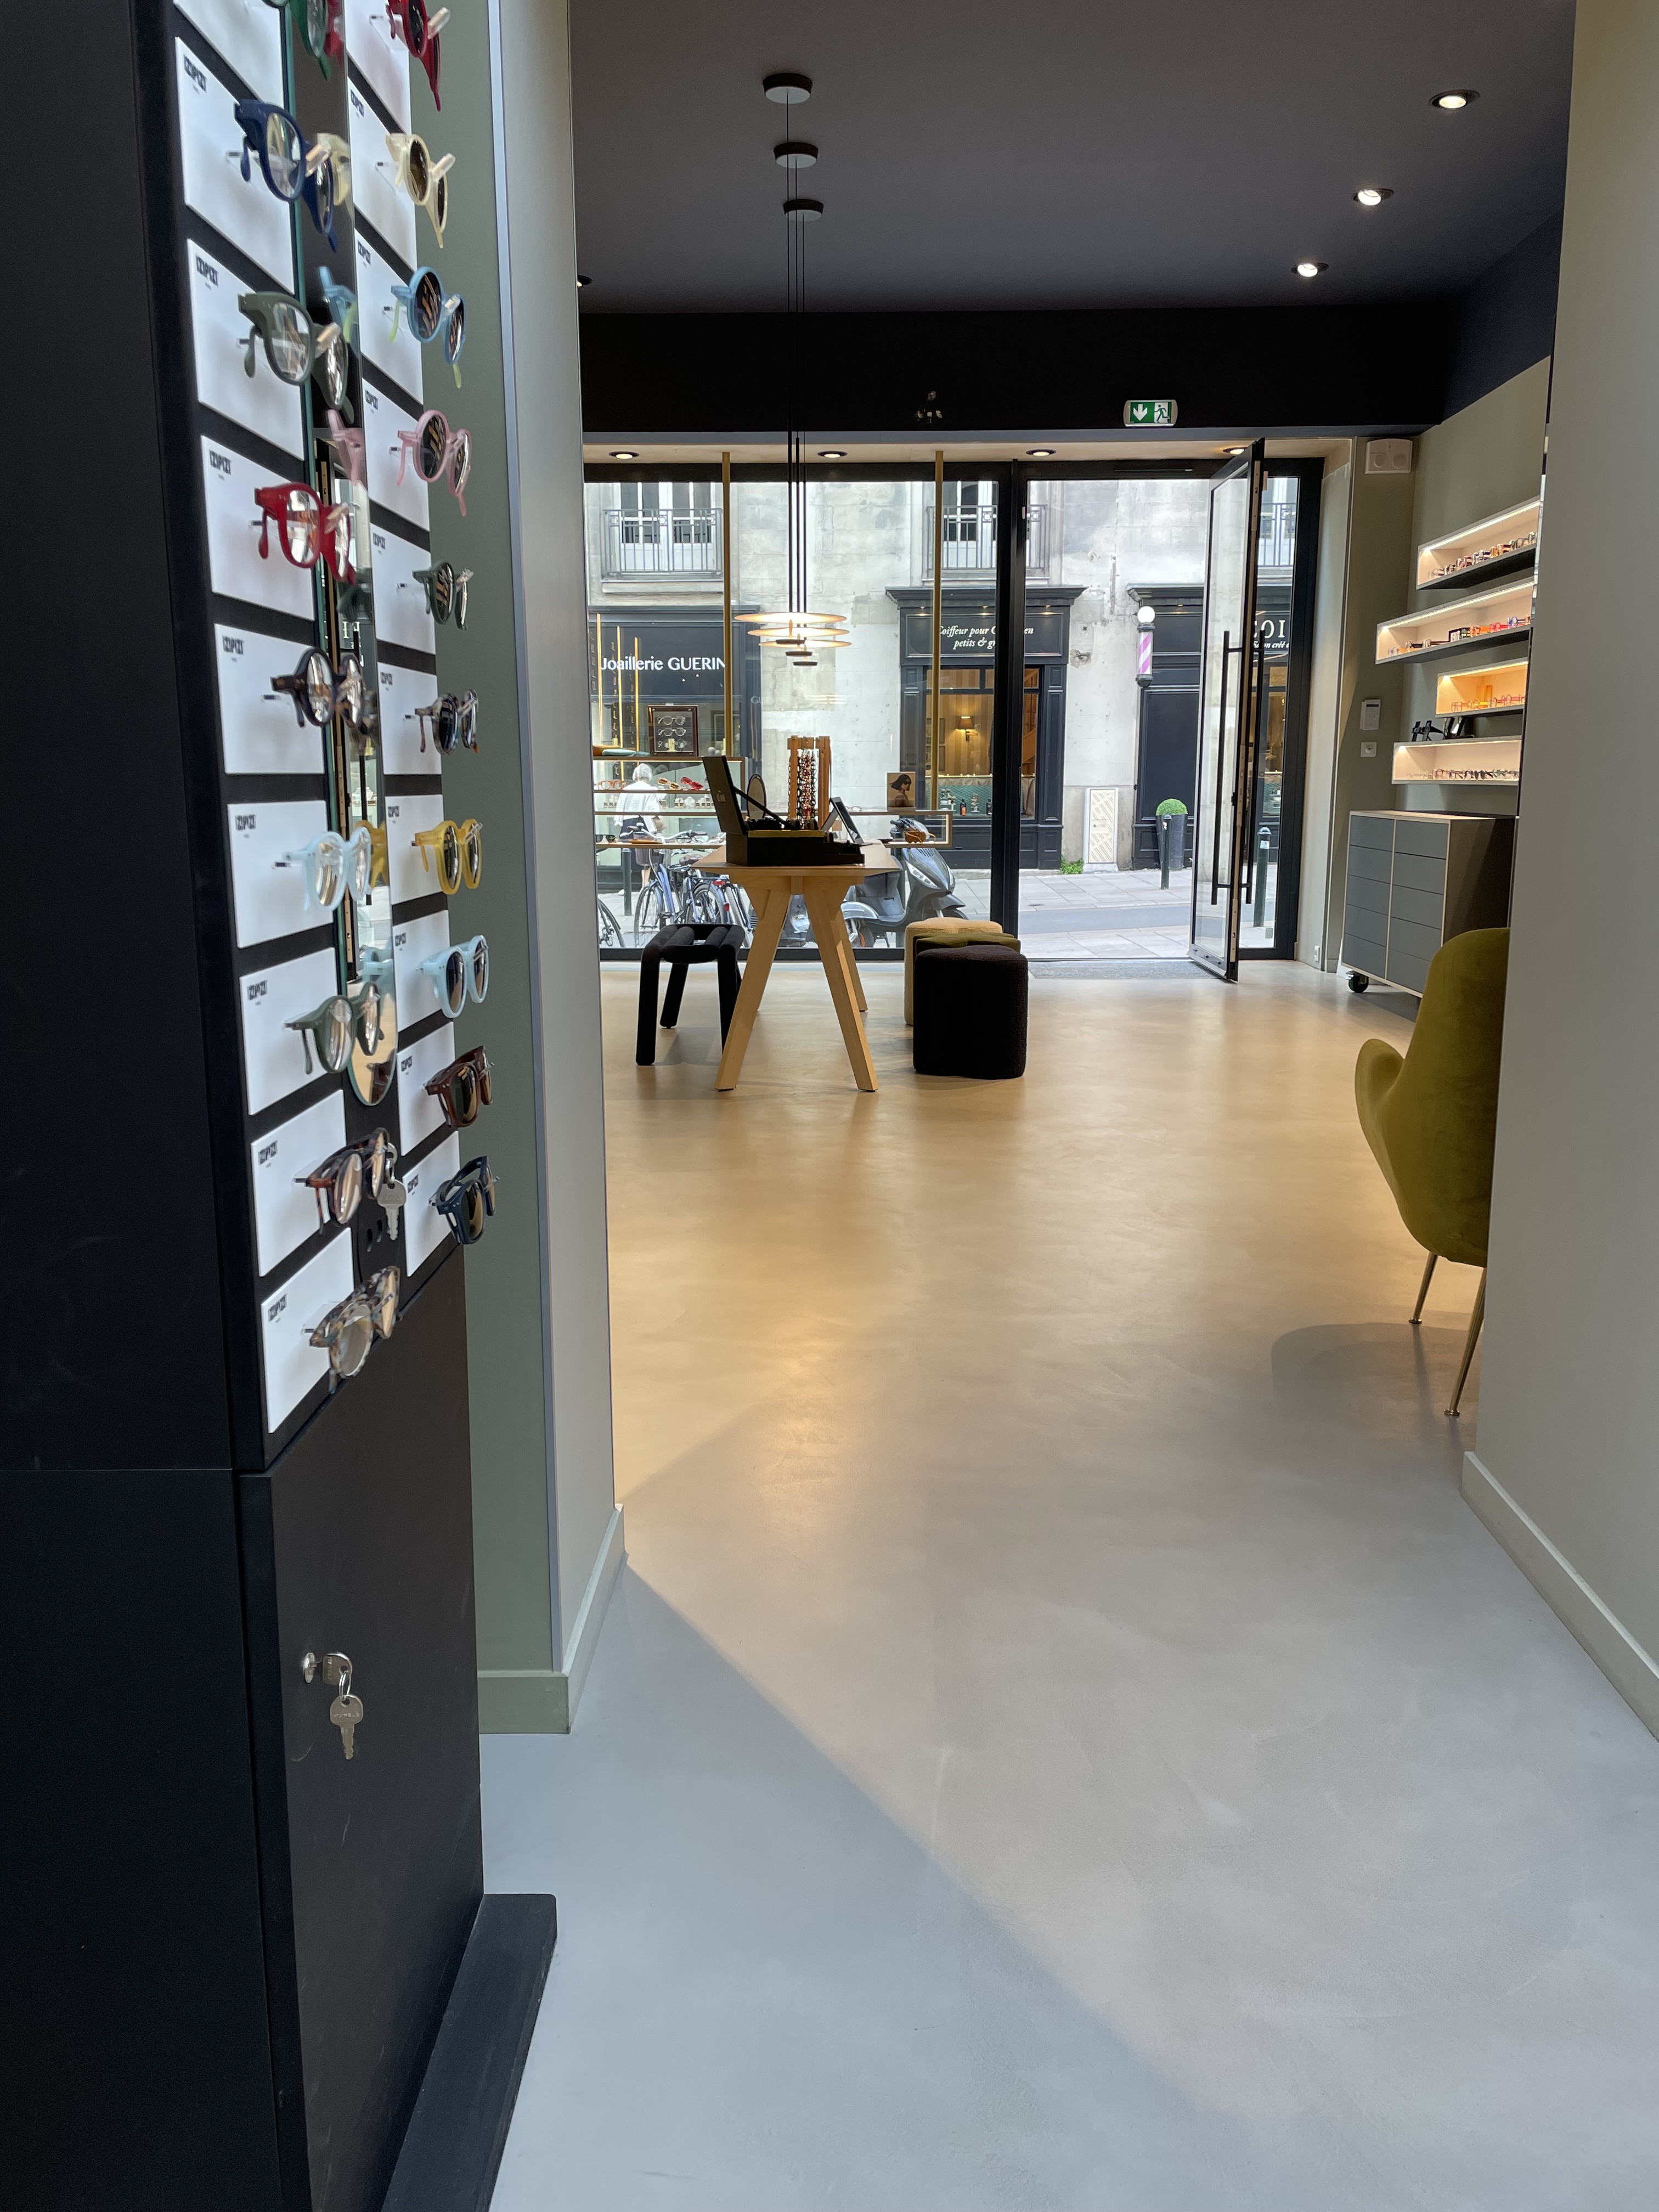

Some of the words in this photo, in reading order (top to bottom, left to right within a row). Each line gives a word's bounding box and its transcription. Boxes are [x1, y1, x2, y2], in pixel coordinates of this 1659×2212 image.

[968, 627, 989, 637] pour
[953, 639, 976, 650] petits
[978, 637, 988, 647] &
[601, 656, 663, 670] Joaillerie
[667, 657, 725, 670] GUERIN
